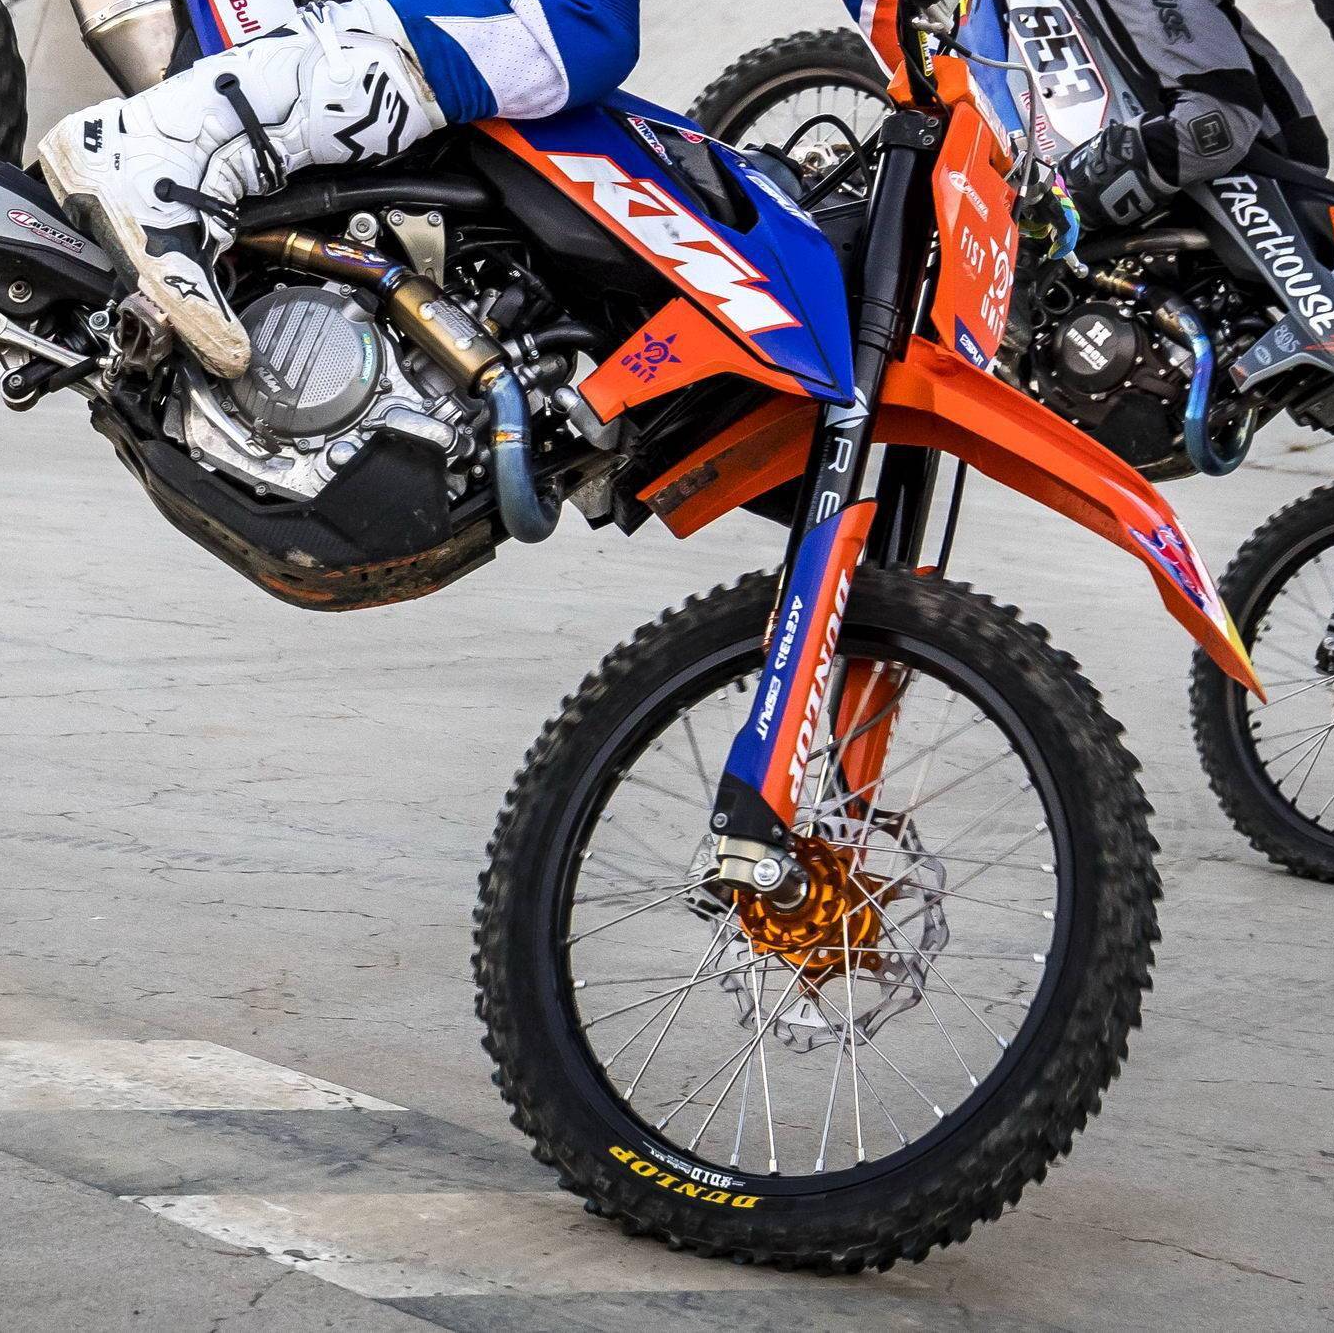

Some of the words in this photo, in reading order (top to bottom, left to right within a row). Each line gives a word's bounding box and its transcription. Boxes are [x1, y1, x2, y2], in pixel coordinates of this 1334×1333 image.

[1009, 6, 1106, 109] 653
[547, 153, 803, 333] KTM
[960, 226, 986, 273] FIST
[980, 294, 1005, 343] UNIT
[621, 355, 657, 383] UNIT
[789, 568, 850, 804] DUNLOP
[608, 1145, 765, 1209] DUNLOP
